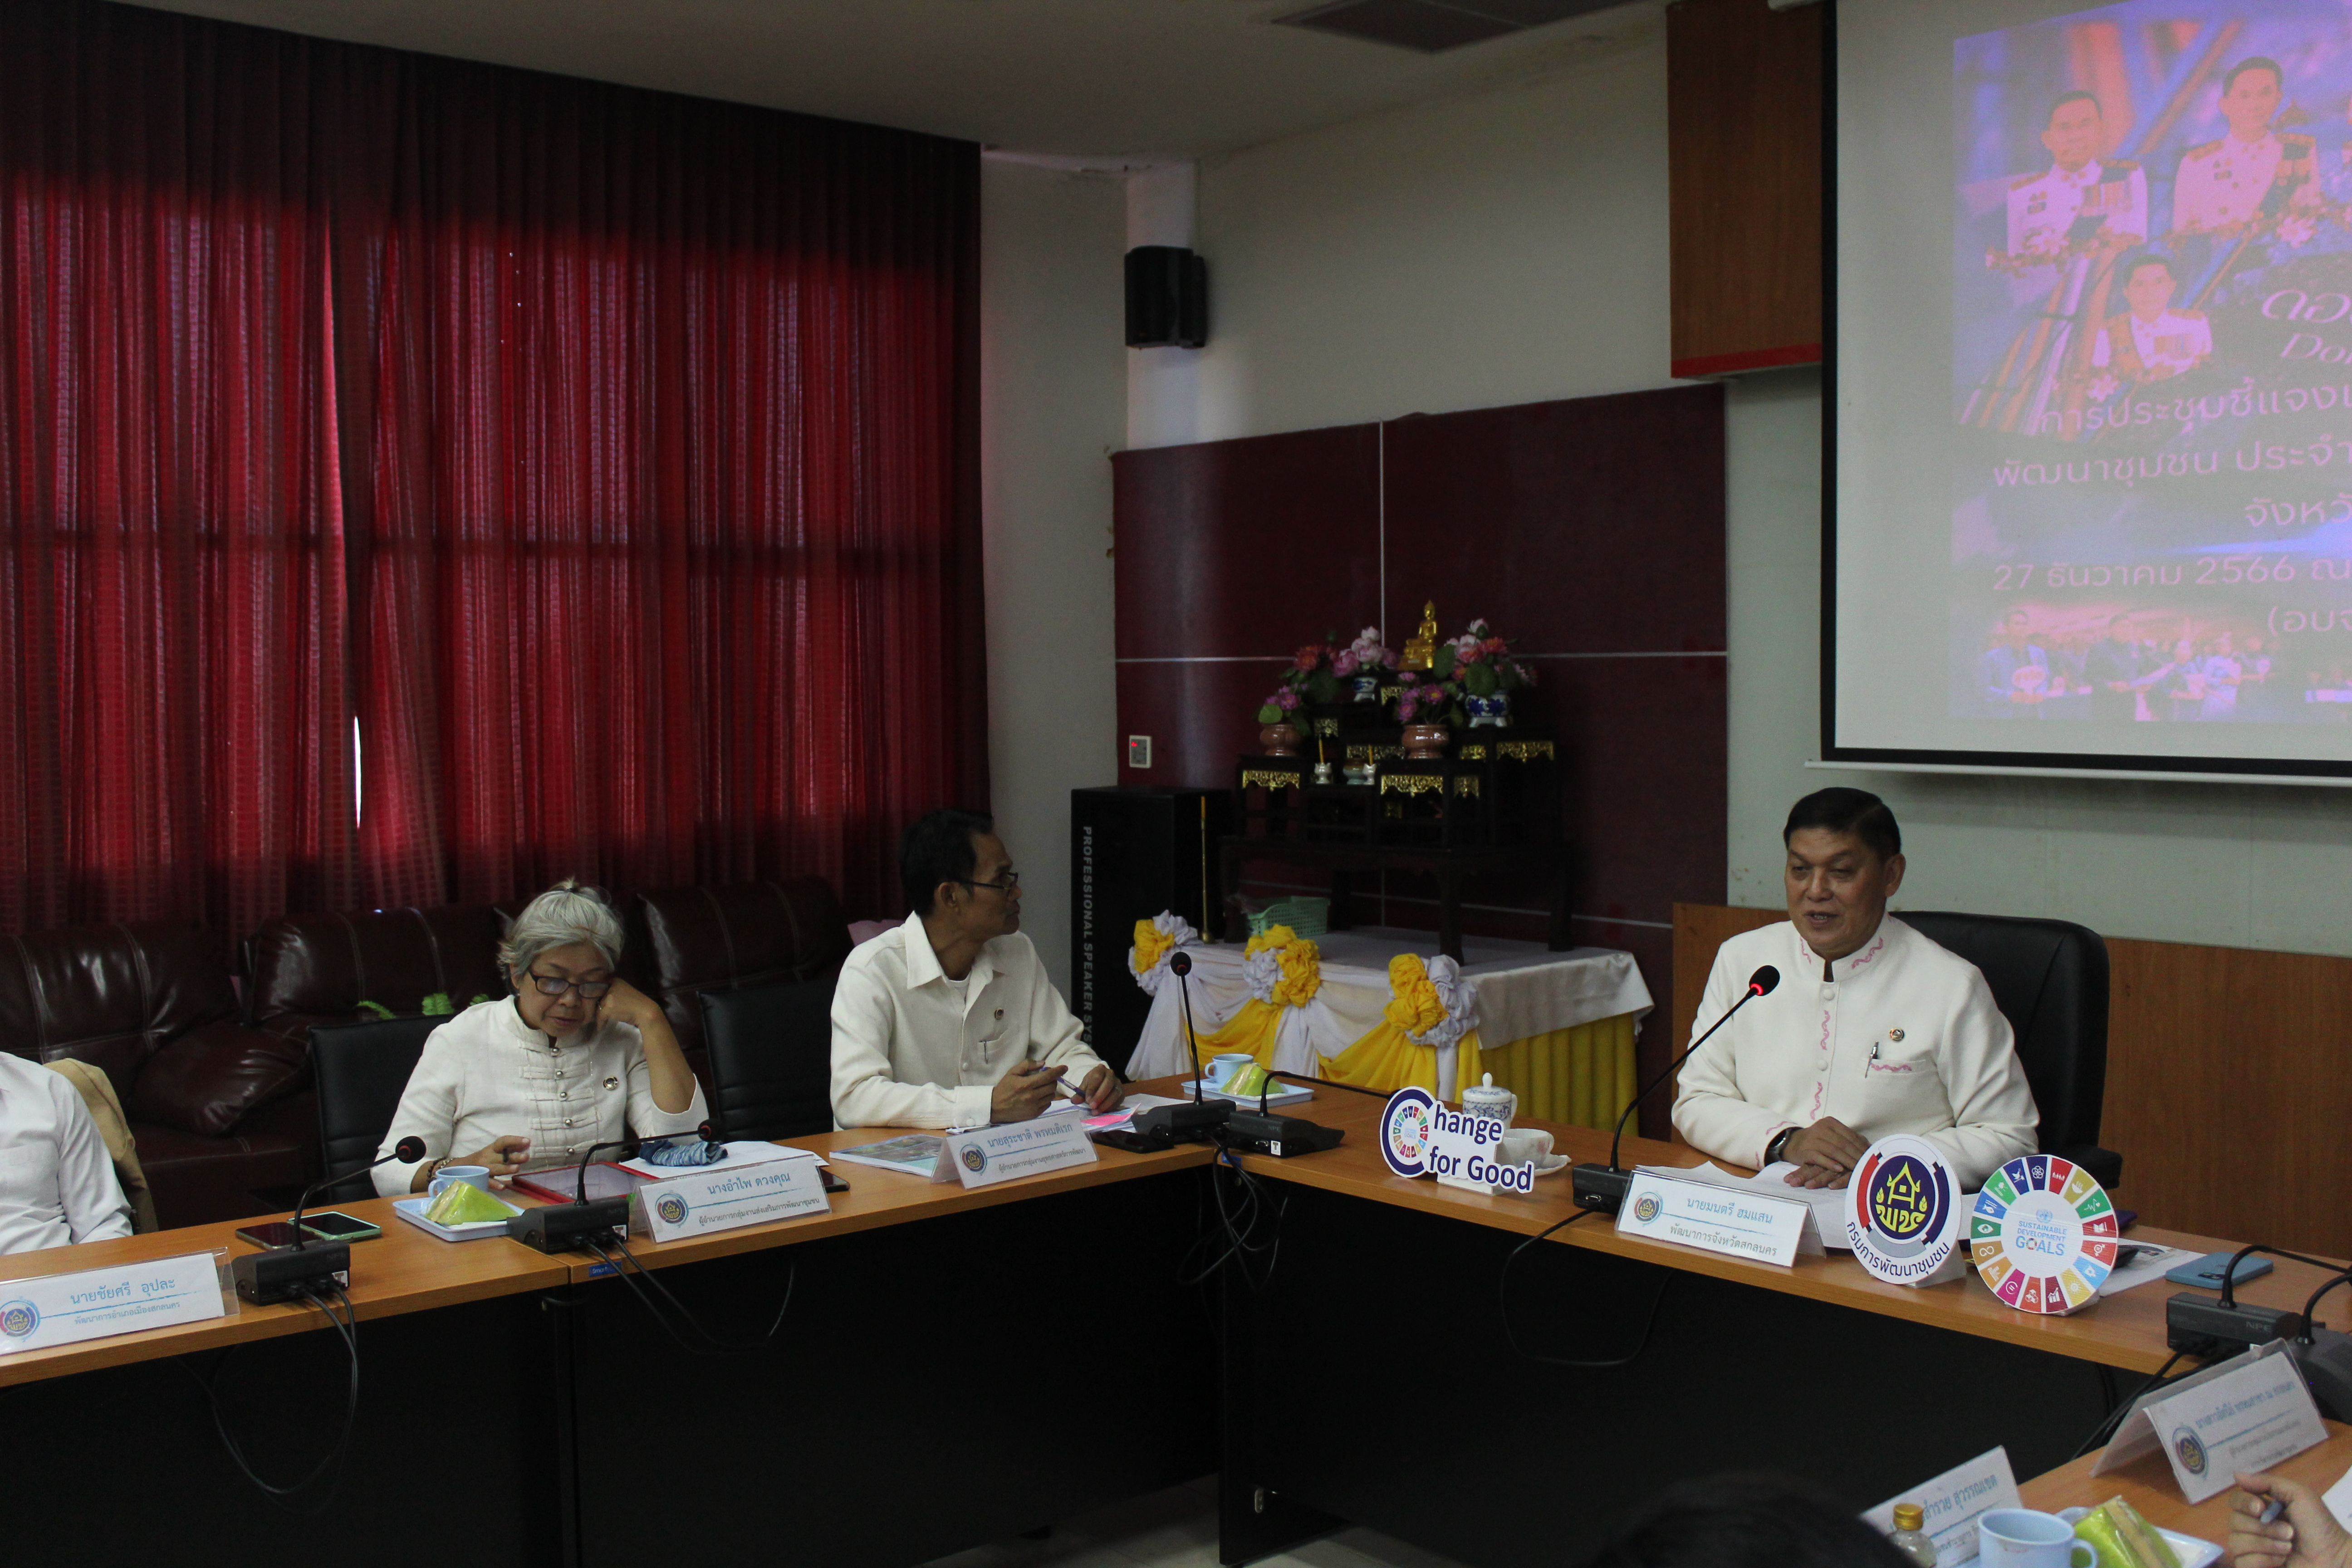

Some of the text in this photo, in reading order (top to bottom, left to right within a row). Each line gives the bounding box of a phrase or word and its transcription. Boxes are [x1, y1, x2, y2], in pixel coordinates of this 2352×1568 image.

[1994, 450, 2218, 487] พัฒนาชุมชน
[1994, 564, 2034, 591] 27
[2047, 561, 2182, 588] ธันวาคม
[2197, 554, 2296, 585] 2566
[1083, 826, 1093, 1047] PROFESSIONAL SPEAKER SYS
[707, 1171, 791, 1195] นางอำไพ ดวงคุณ
[1430, 1146, 1532, 1191] for Good
[1687, 1197, 1774, 1224] นายมนตรี ฮมแสน
[1670, 1223, 1777, 1256] พัฒนาการจังหวัดสกลนคร
[2017, 1228, 2066, 1243] DEVELOPMENT
[2019, 1220, 2067, 1235] SUSTAINABLE
[1847, 1221, 1950, 1277] กรมการพัฒนาชุมชน
[2016, 1236, 2064, 1256] GOALS
[70, 1277, 176, 1304] นายชัยศรี อุปละ
